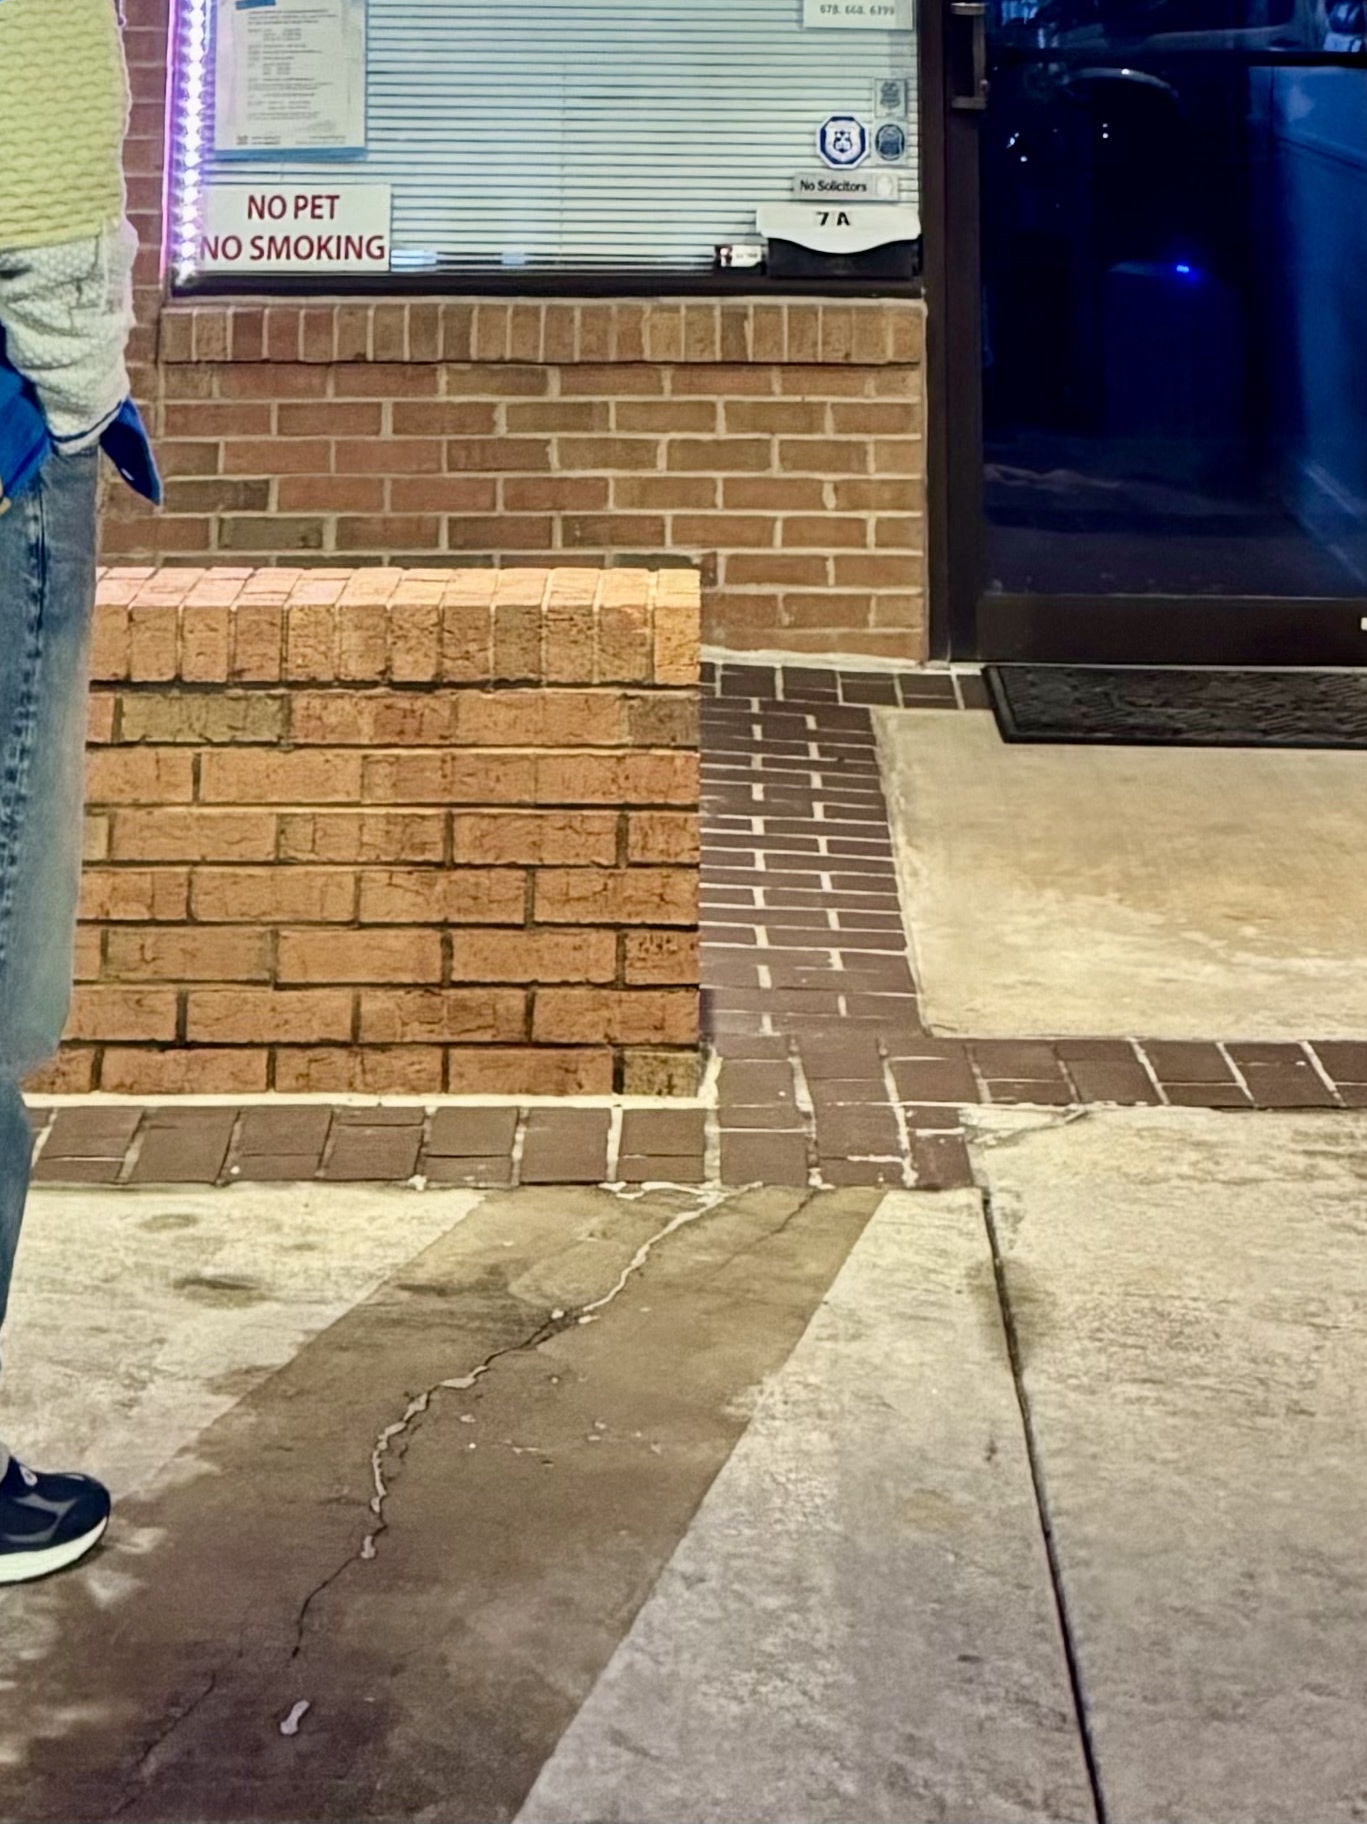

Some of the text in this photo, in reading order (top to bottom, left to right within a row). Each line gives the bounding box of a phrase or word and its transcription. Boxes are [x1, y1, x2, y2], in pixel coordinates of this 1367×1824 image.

[800, 180, 868, 192] No Solicitors
[247, 195, 340, 220] NO PET
[200, 235, 386, 261] NO SMOKING
